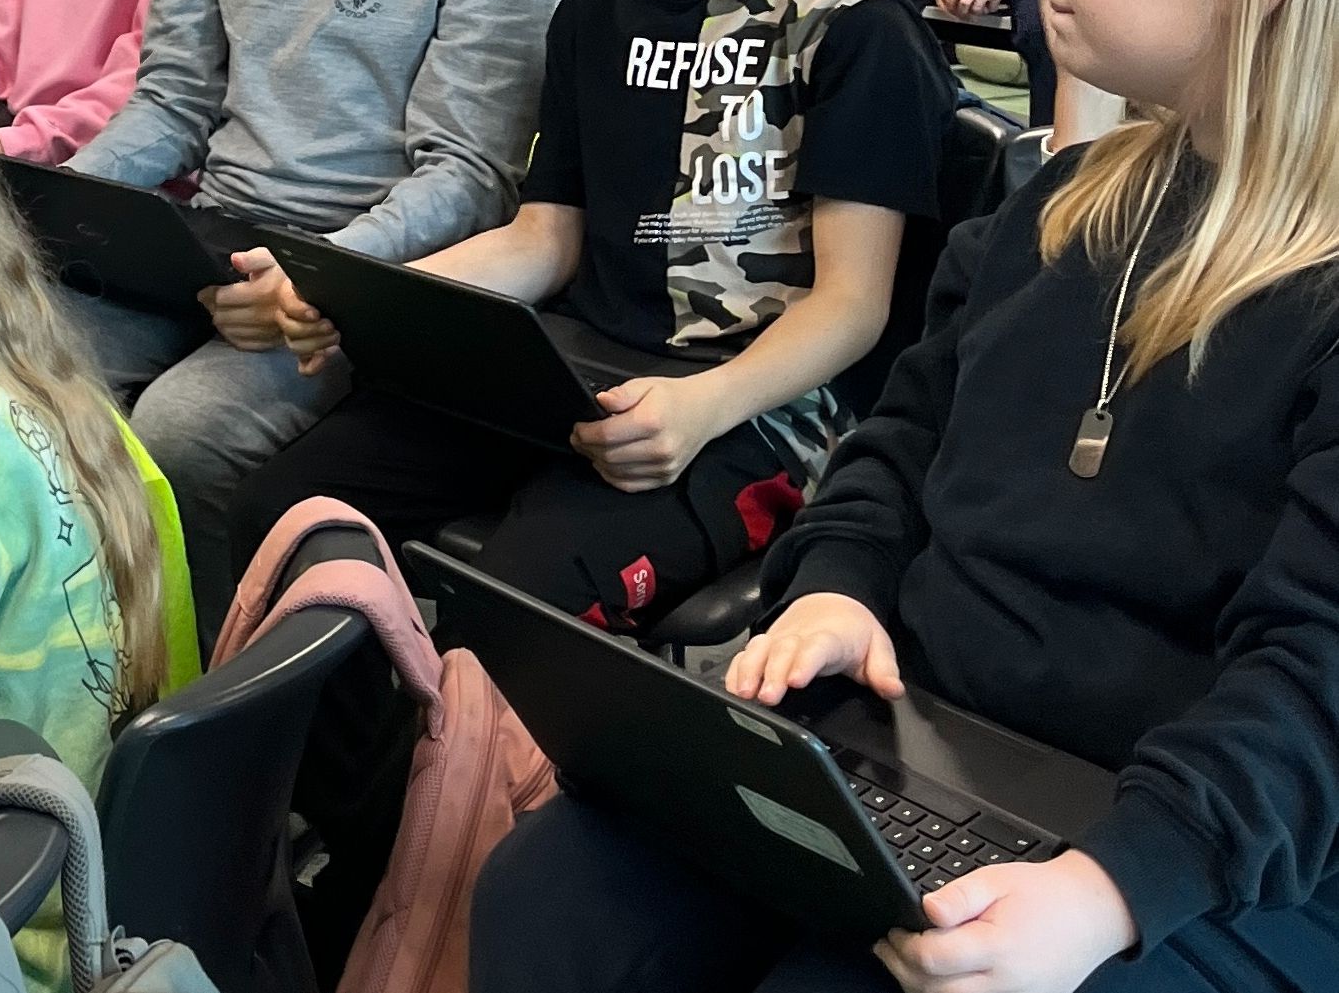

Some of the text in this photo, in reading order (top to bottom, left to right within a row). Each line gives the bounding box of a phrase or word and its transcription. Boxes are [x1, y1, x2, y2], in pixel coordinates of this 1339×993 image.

[626, 37, 765, 90] REFUSE
[720, 89, 764, 142] TO
[691, 150, 789, 205] LOSE
